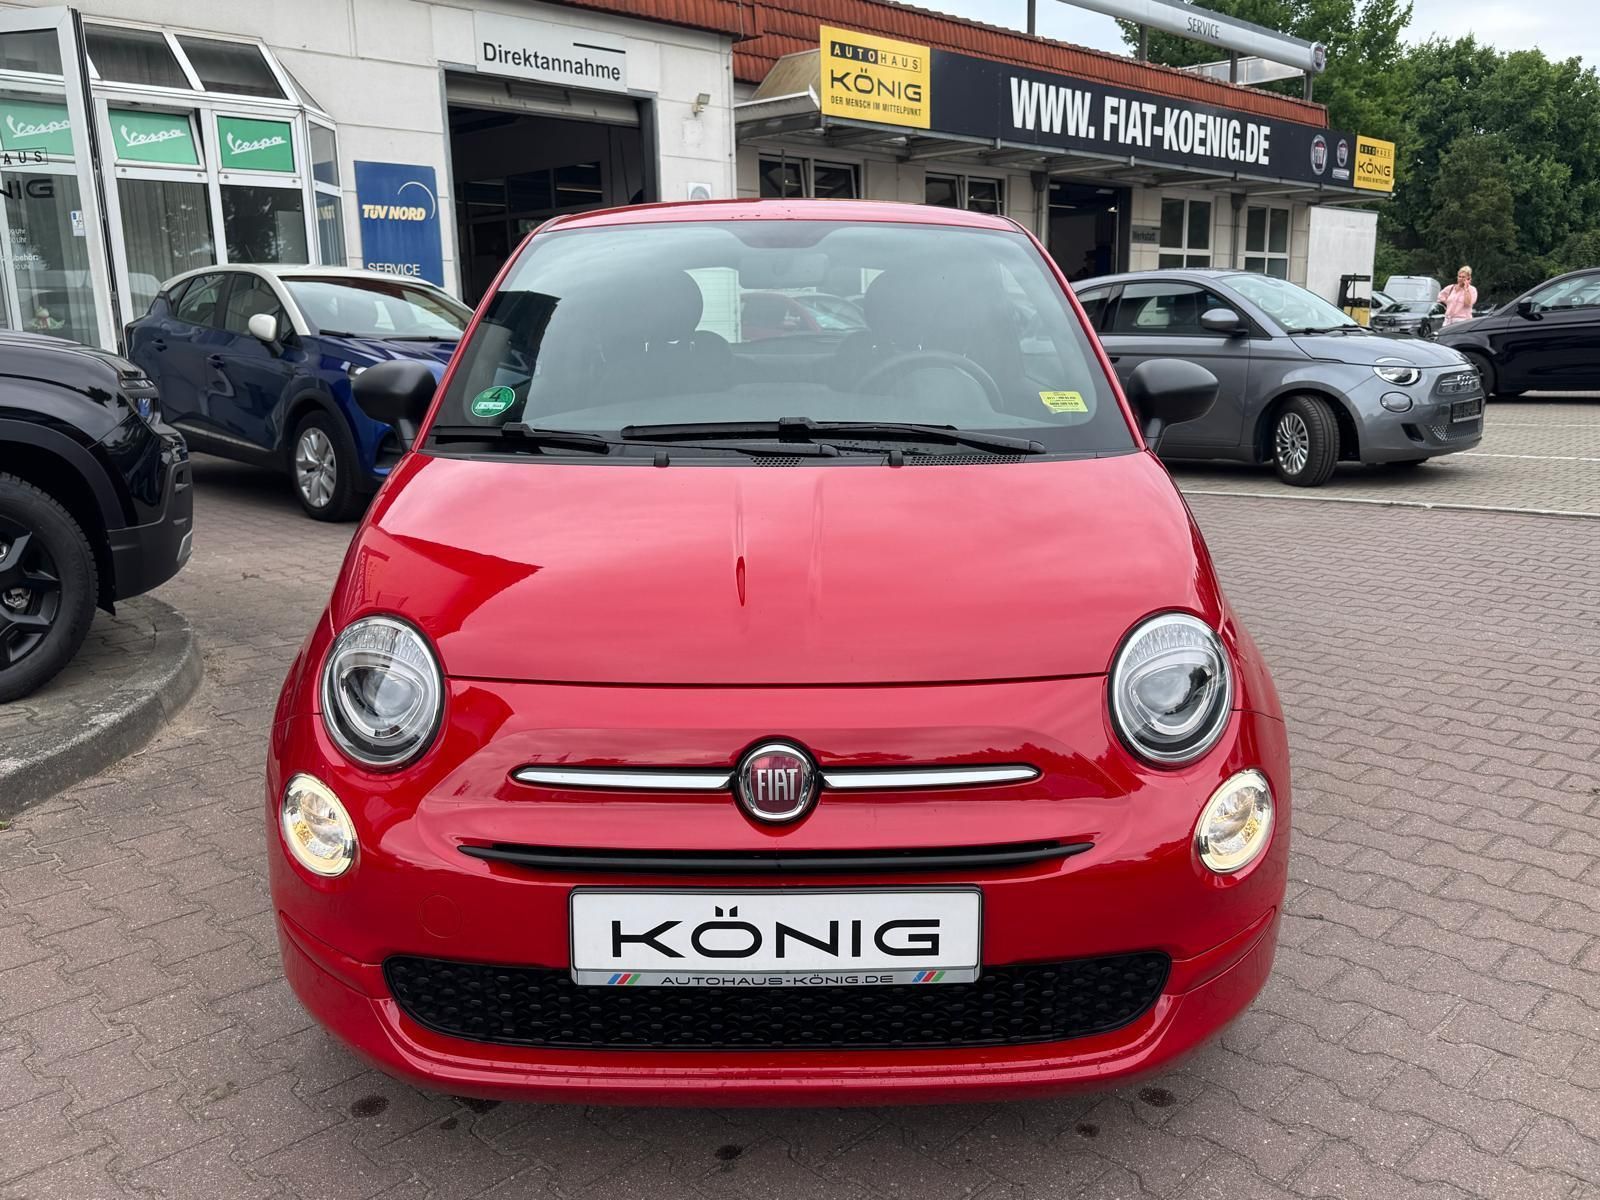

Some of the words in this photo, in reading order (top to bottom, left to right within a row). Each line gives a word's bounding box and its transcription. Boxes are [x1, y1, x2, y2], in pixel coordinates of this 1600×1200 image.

[1187, 17, 1220, 39] SERVICE
[483, 42, 621, 81] Direktannahme
[833, 44, 919, 70] AUTOHAUS
[830, 67, 922, 103] KÖNIG
[831, 95, 843, 105] DER
[845, 97, 871, 109] MENSCH
[873, 102, 881, 110] IM
[882, 103, 922, 116] MITTELPUNKT
[1010, 77, 1096, 140] WWW.
[1103, 96, 1271, 166] FIAT-KOENIG.DE
[120, 124, 187, 147] Vespa
[226, 132, 287, 155] Vespa
[1358, 158, 1391, 177] KÖNIG
[362, 204, 388, 219] TÜV
[388, 206, 426, 221] NORD
[367, 263, 421, 275] SERVICE
[489, 387, 504, 402] 4
[757, 768, 799, 801] FIAT
[611, 905, 941, 958] KÖNIG
[661, 974, 894, 986] AUTOHAUS-KÖNIG.DE
